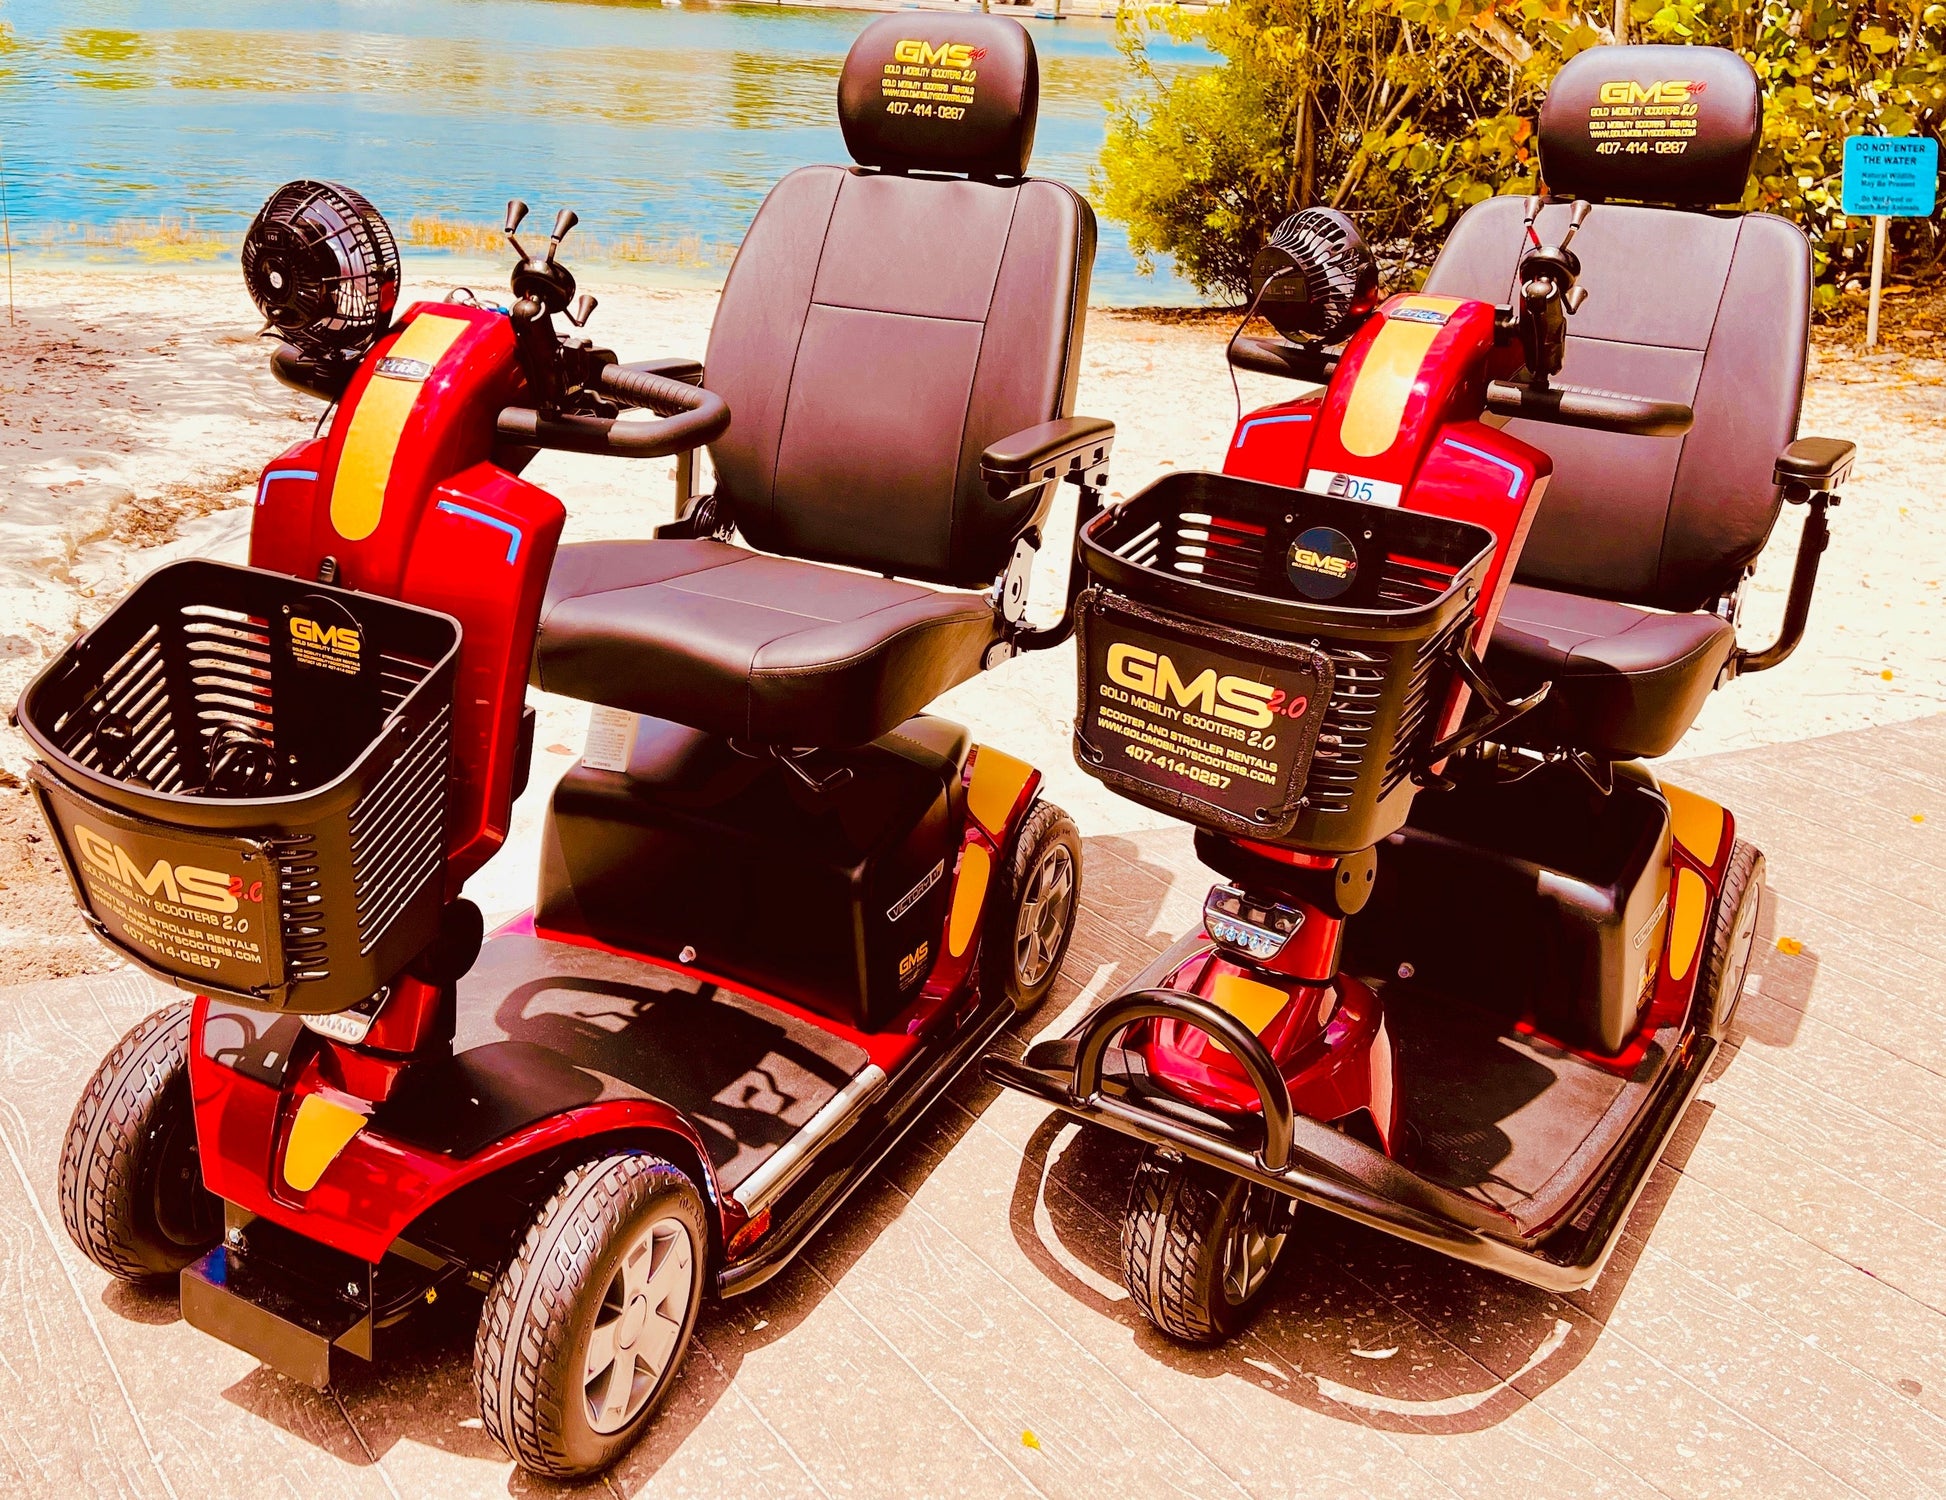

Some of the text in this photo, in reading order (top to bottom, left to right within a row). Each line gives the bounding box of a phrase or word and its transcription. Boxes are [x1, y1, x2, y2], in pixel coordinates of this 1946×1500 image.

[894, 40, 975, 68] GMS
[884, 64, 977, 83] GOLD MOBILITY SCOOTERS 2.0
[1600, 80, 1692, 104] GMS
[886, 101, 966, 120] 407-414-0287
[1590, 104, 1698, 117] GOLD MOBILITY SCOOTERS 2.0
[1596, 141, 1688, 155] 407-414-0287
[1856, 143, 1869, 151] DO
[1894, 144, 1926, 153] ENTER
[1863, 156, 1917, 165] THE WATER
[1295, 549, 1347, 573] GMS
[290, 617, 360, 652] GMS
[1106, 642, 1307, 729] GMS 2.0
[1100, 684, 1277, 751] GOLD MOBILITY SCOOTERS 2.0
[1097, 717, 1276, 785] WWW.GOLDMOBILITYSCOOTERS.COM
[1099, 706, 1278, 773] SCOOTER AND STROLLER RENTALS
[1125, 744, 1231, 789] 407-414-0287
[74, 824, 239, 914] GMS
[82, 861, 249, 934] GOLD MOBILITY SCOOTERS 2.0
[892, 877, 930, 916] VICTORY
[89, 880, 260, 953] SCOOTER AND STROLLER RENTALS
[92, 892, 262, 964] WWW.GOLDMOBILITYSCOOTERS.COM
[122, 922, 221, 970] 407-414-0287
[899, 940, 928, 975] GMS
